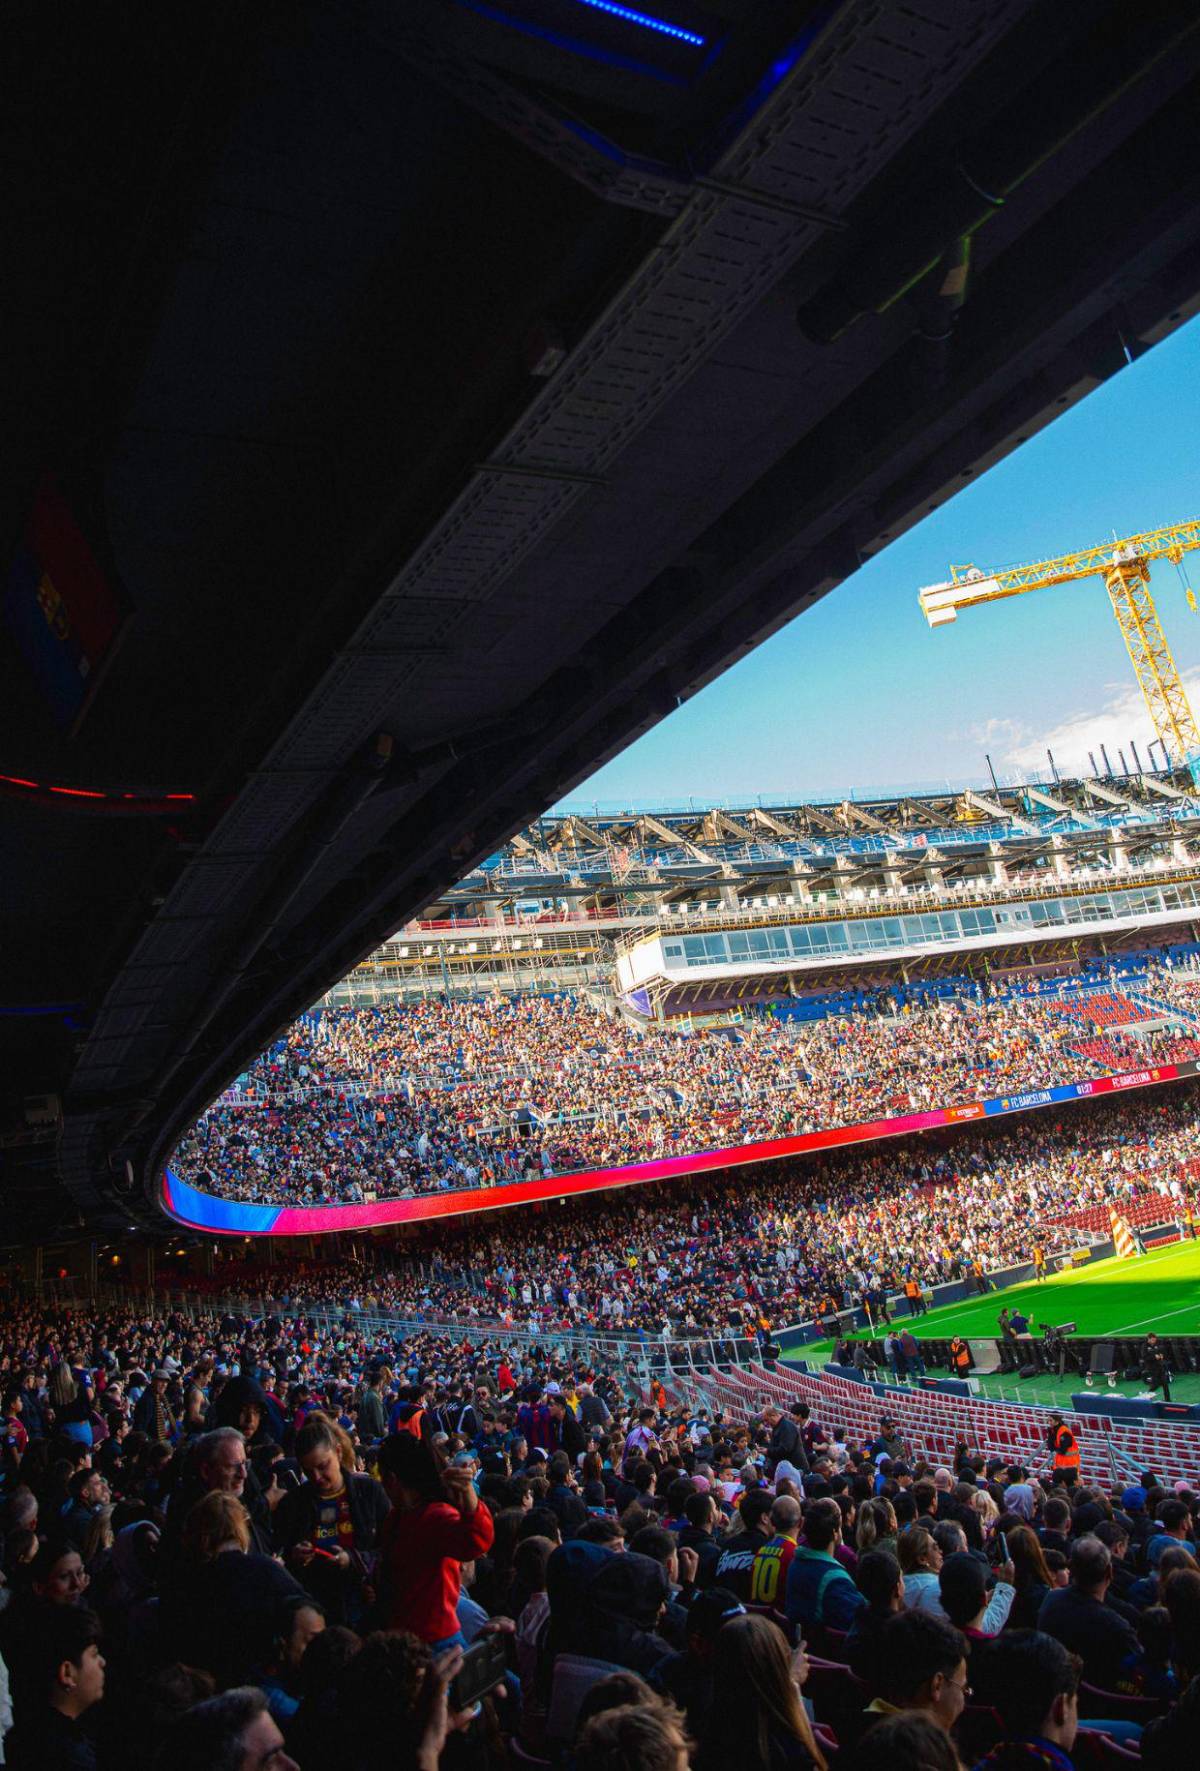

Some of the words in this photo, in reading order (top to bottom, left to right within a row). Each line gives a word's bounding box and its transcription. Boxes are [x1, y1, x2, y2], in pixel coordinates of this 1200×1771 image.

[1112, 1078, 1121, 1088] FC
[1120, 1072, 1152, 1087] BARCELONA
[1010, 1097, 1020, 1109] FC
[1018, 1091, 1052, 1107] BARCELONA
[752, 1557, 781, 1602] 10
